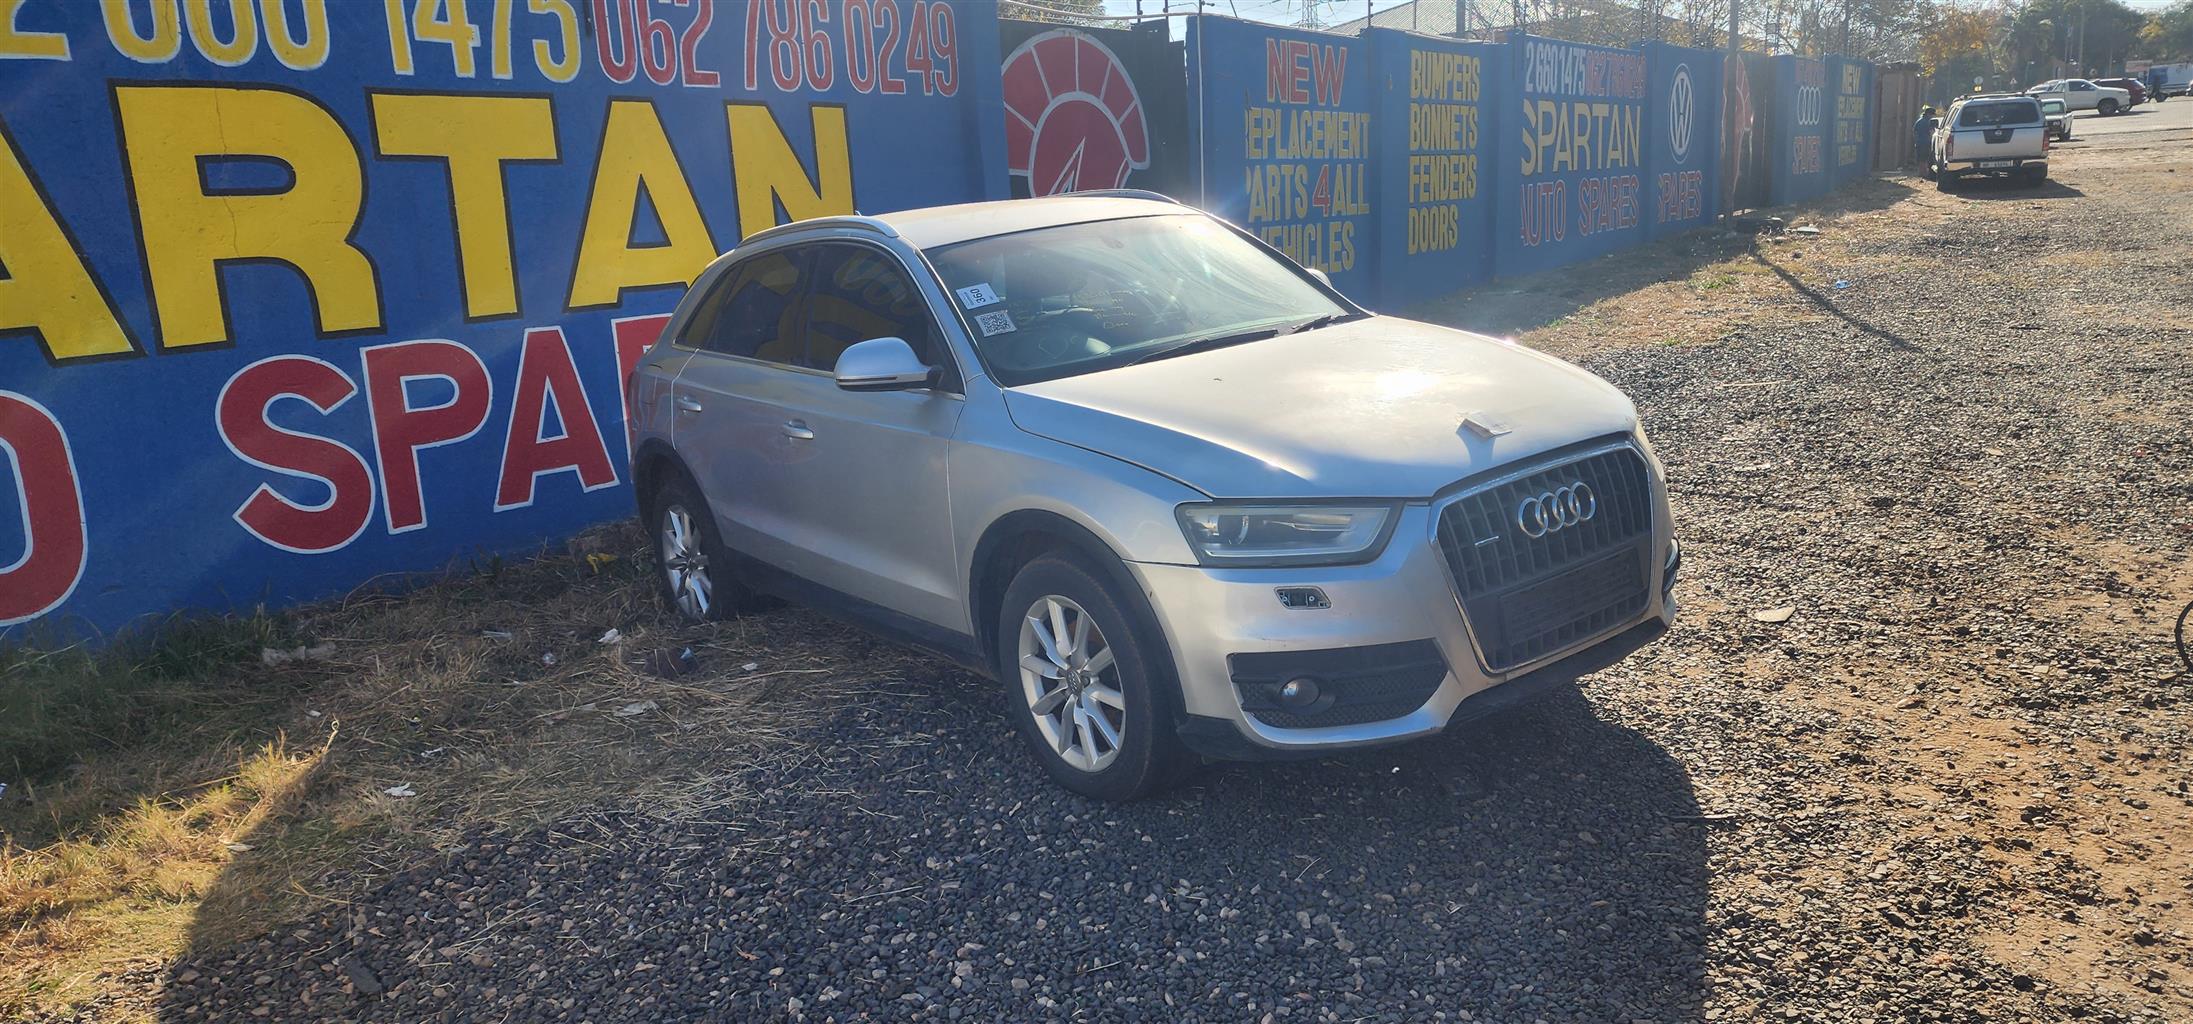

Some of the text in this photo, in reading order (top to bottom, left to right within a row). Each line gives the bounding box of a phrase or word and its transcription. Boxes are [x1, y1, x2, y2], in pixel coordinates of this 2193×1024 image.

[593, 0, 959, 96] 062 786 0249
[1266, 38, 1347, 107] NEW
[1410, 49, 1480, 101] BUMPERS
[1409, 102, 1478, 151] BONNETS
[1521, 98, 1641, 176] SPARTAN
[1408, 153, 1477, 203] FENDERS
[1407, 203, 1458, 255] DOORS
[1578, 174, 1640, 237] SPARES
[1247, 221, 1356, 274] EHICLES
[970, 288, 986, 304] 360
